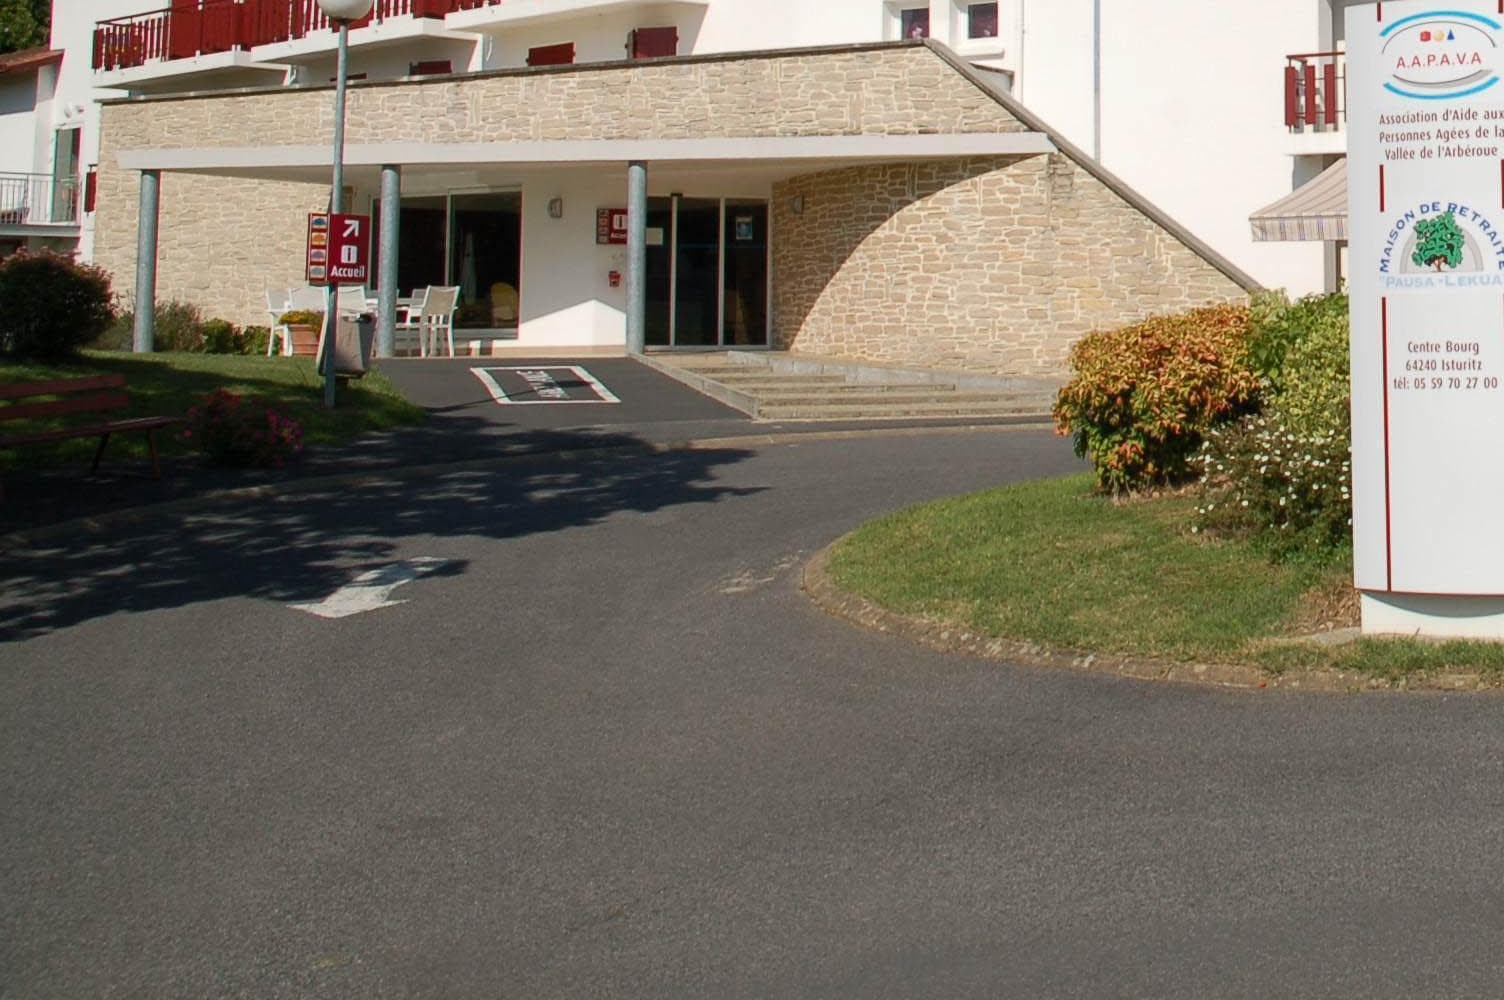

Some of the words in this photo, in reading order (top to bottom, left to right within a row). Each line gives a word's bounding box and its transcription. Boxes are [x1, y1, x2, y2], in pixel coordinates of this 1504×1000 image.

[1396, 52, 1482, 69] A.A.P.A.V.A
[1379, 111, 1438, 125] Association
[1442, 108, 1478, 122] d'Aide
[1483, 109, 1504, 120] aux
[1379, 130, 1431, 144] Personnes
[1435, 128, 1470, 142] Agées
[1475, 126, 1489, 138] de
[1494, 126, 1504, 138] la
[1384, 147, 1415, 161] Vallée
[1420, 146, 1433, 158] de
[1438, 145, 1498, 158] l'Arbéroue
[1380, 210, 1415, 273] MAISON
[1420, 201, 1441, 215] DE
[330, 265, 365, 278] Accueil
[1407, 341, 1441, 353] Centre
[1446, 341, 1480, 355] Bourg
[1405, 359, 1437, 371] 64240
[1441, 358, 1482, 371] Isturitz
[1393, 377, 1410, 390] tél:
[1414, 378, 1426, 389] 05
[1431, 378, 1443, 389] 59
[1448, 378, 1461, 389] 70
[1466, 377, 1478, 389] 27
[1483, 377, 1498, 389] 00
